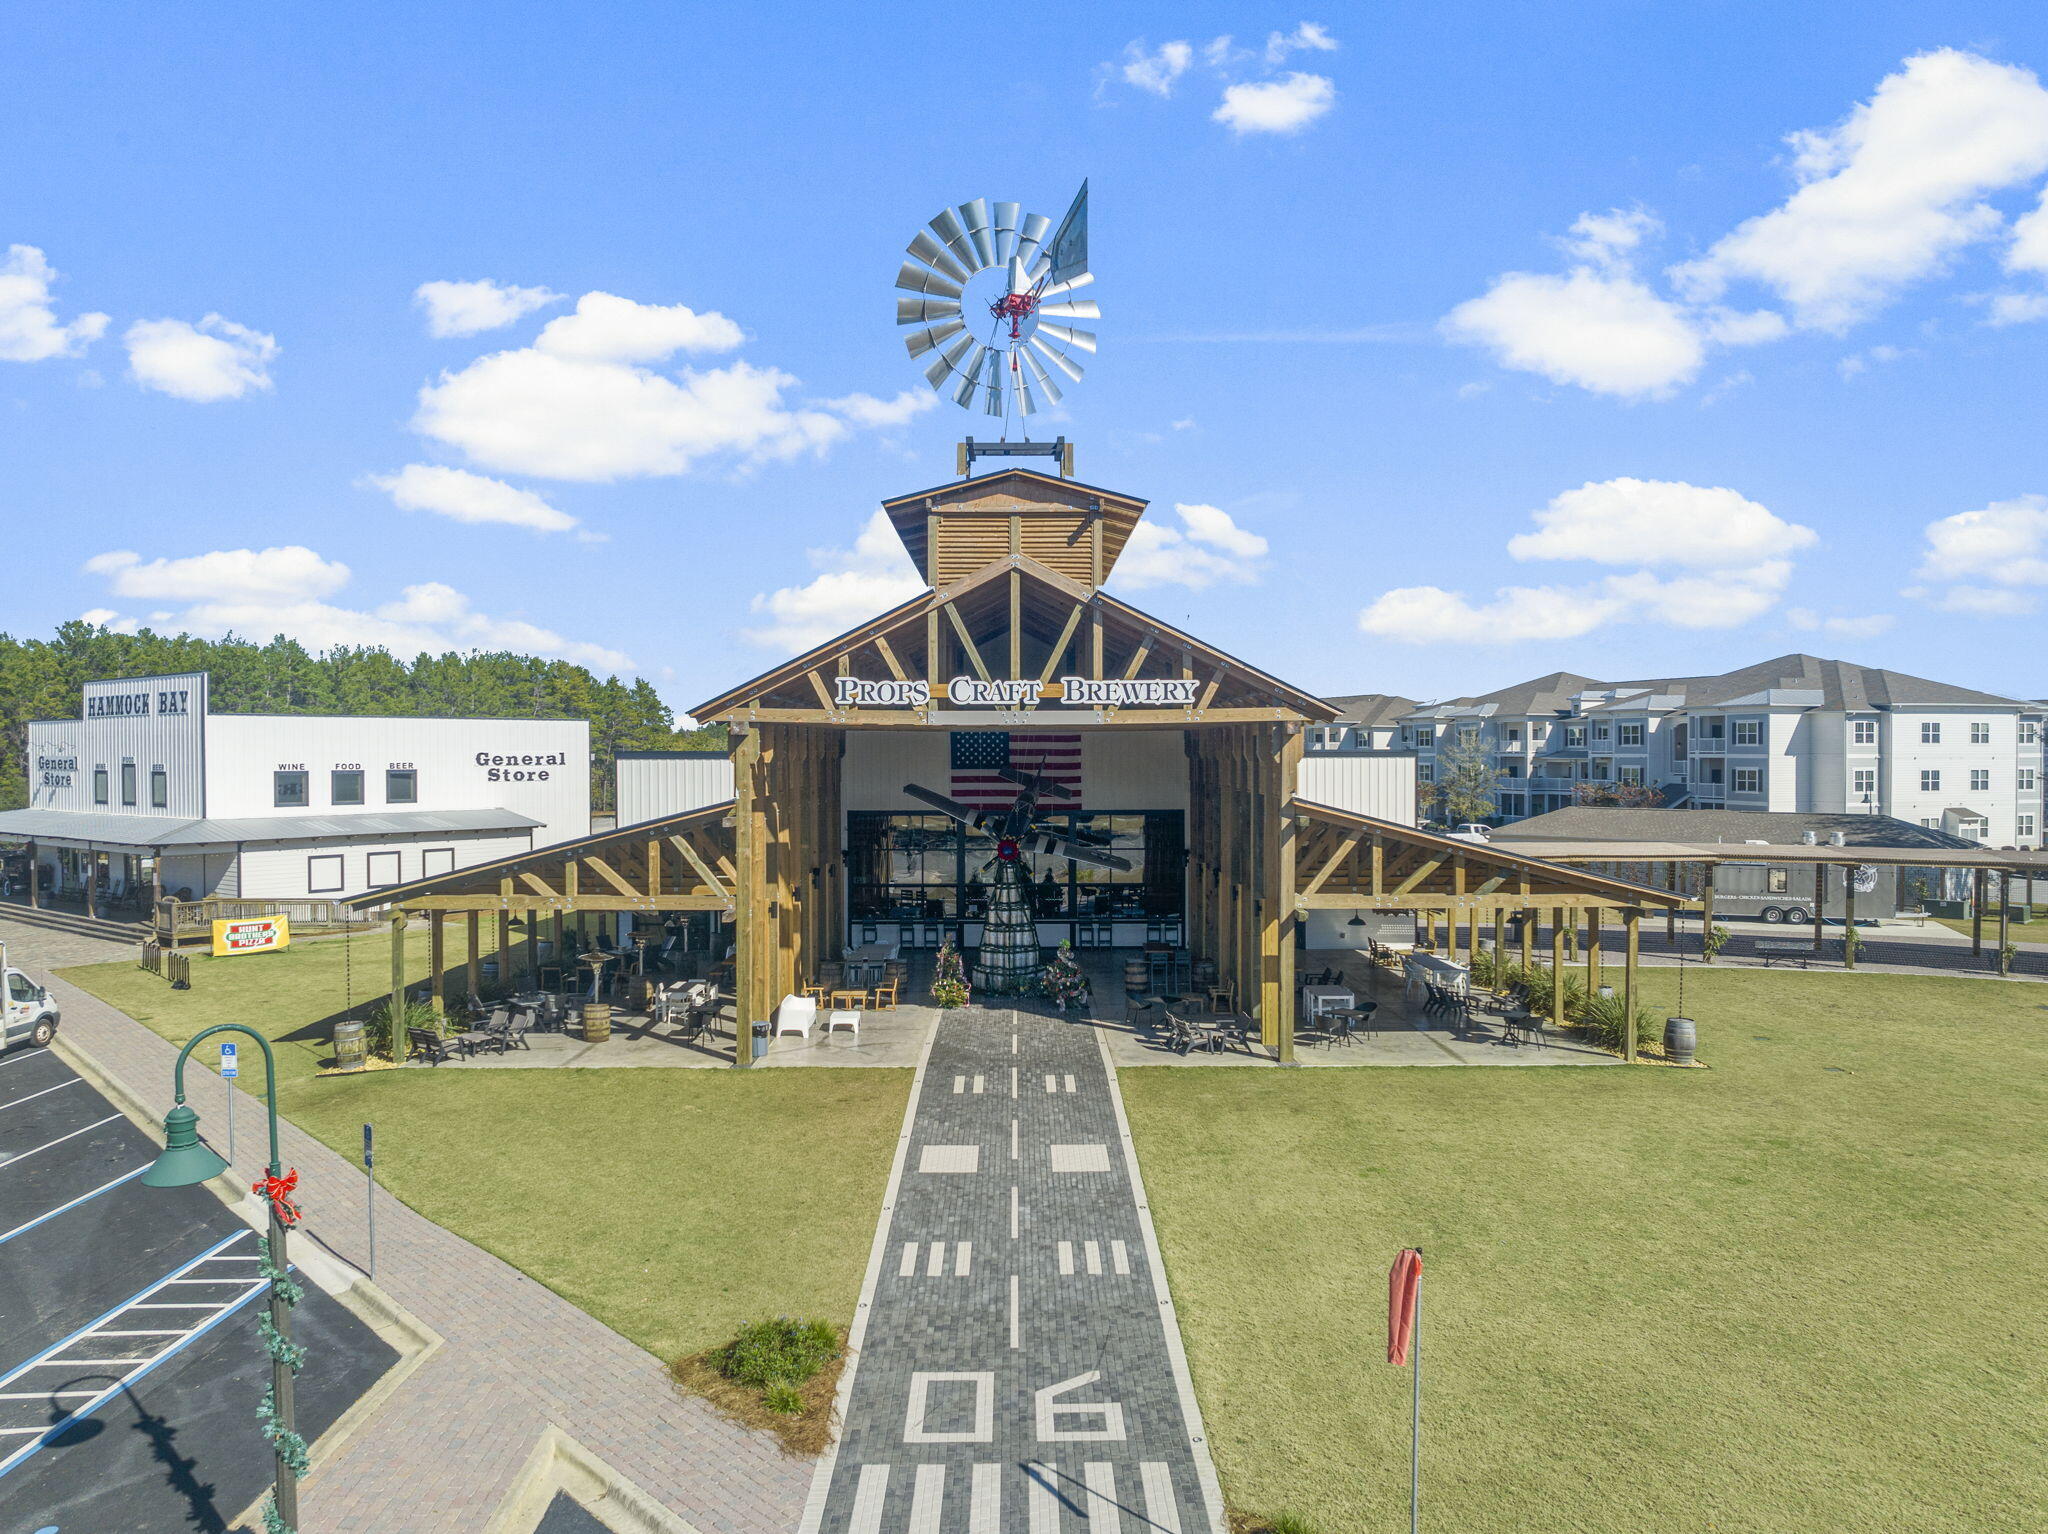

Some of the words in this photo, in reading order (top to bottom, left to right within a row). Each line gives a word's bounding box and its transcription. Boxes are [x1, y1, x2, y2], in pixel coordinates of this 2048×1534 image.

[838, 678, 930, 703] PROPS
[949, 678, 1042, 703] CRAFT
[1063, 678, 1200, 703] BREWERY
[87, 693, 150, 717] HAMMOCK
[158, 690, 189, 714] BAY
[38, 756, 78, 770] General
[389, 762, 415, 770] BEER
[475, 752, 566, 766] General
[278, 763, 306, 771] WINE
[43, 772, 72, 786] Store
[487, 768, 550, 782] Store
[238, 924, 265, 933] HUNT
[238, 937, 266, 947] PIZZA
